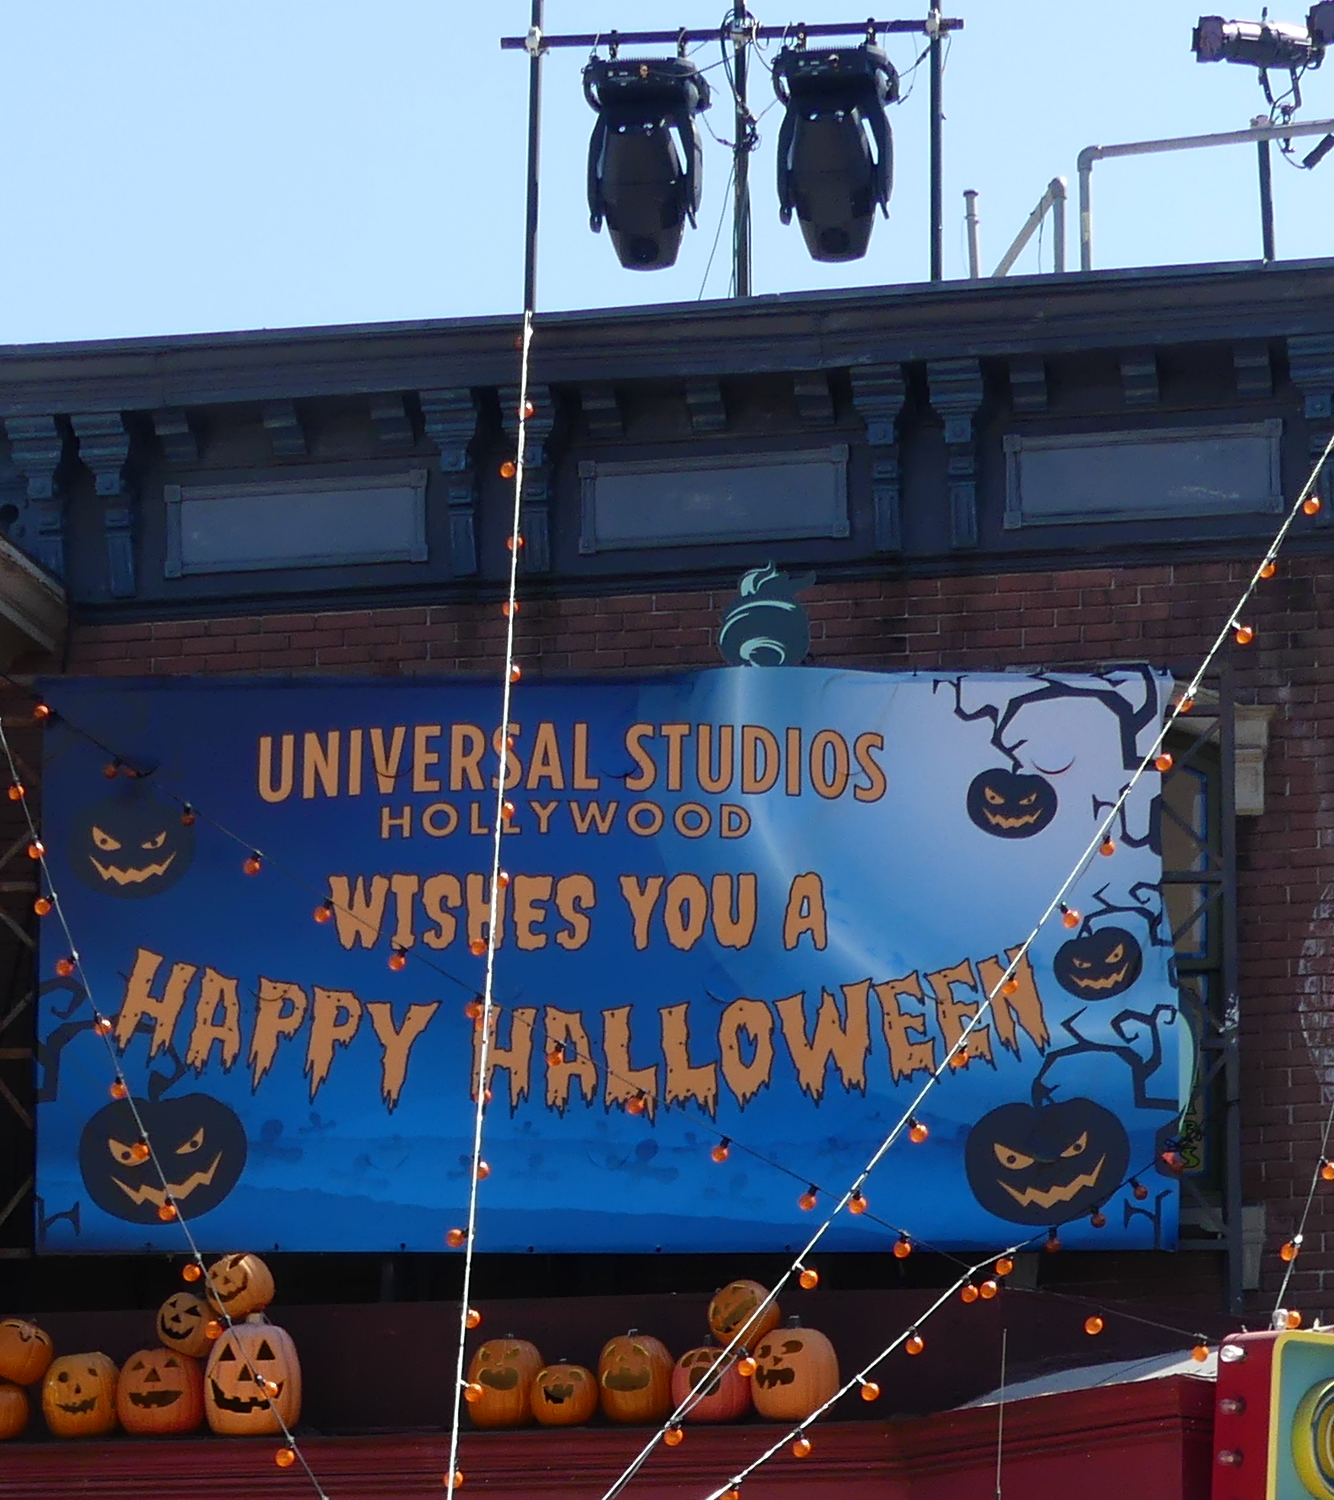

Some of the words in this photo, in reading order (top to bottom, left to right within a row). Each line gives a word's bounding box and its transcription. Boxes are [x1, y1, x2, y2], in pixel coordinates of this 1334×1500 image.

[256, 722, 601, 804] UNIVERSAL
[623, 722, 888, 804] STUDIOS
[380, 800, 753, 839] HOLLYWOOD
[327, 873, 597, 951] WISHES
[620, 872, 759, 951] YOU
[783, 872, 828, 951] A
[112, 947, 441, 1115] HAPPY
[469, 942, 1051, 1127] HALLOWEEN
